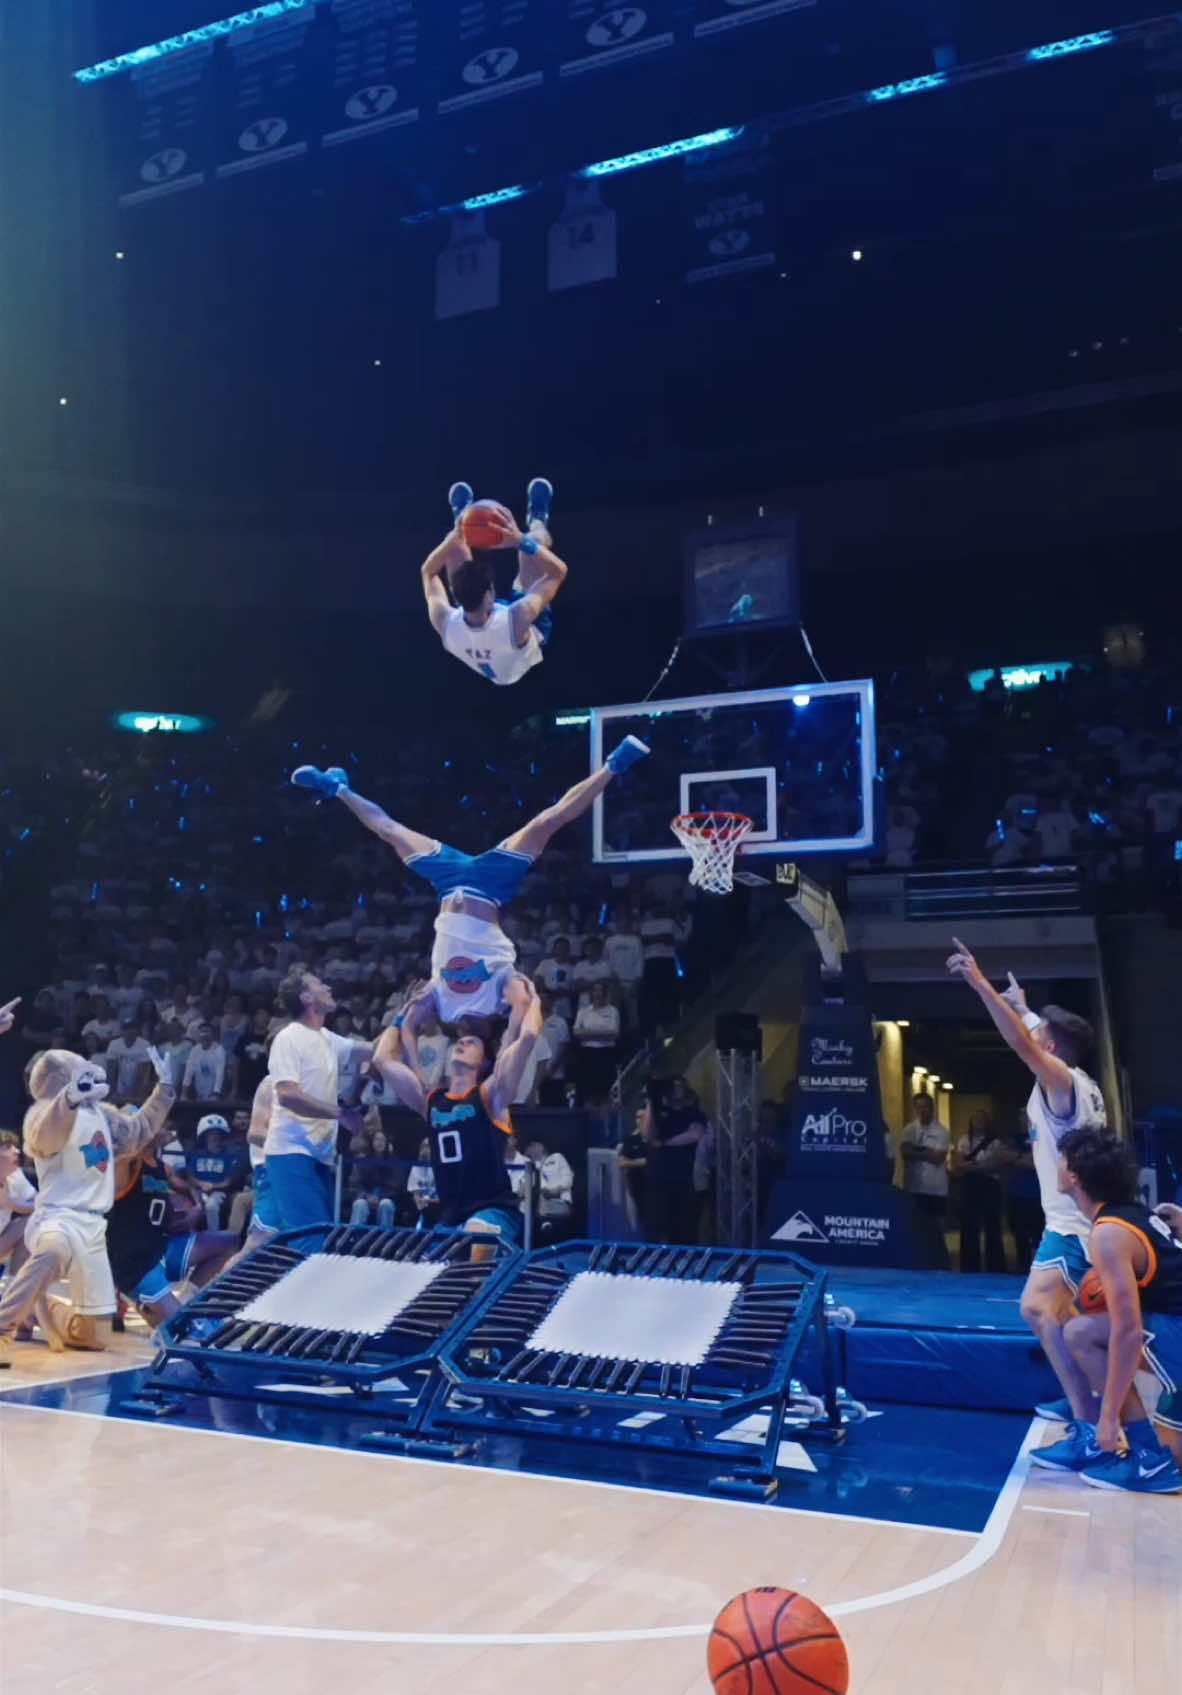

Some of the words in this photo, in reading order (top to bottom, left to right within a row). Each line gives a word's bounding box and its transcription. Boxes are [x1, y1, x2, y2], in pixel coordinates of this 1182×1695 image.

[810, 1076, 868, 1087] MAERSK
[438, 1130, 463, 1163] 0
[149, 1198, 166, 1226] 0
[824, 1215, 890, 1230] MOUNTAIN
[828, 1227, 886, 1241] AMERICA
